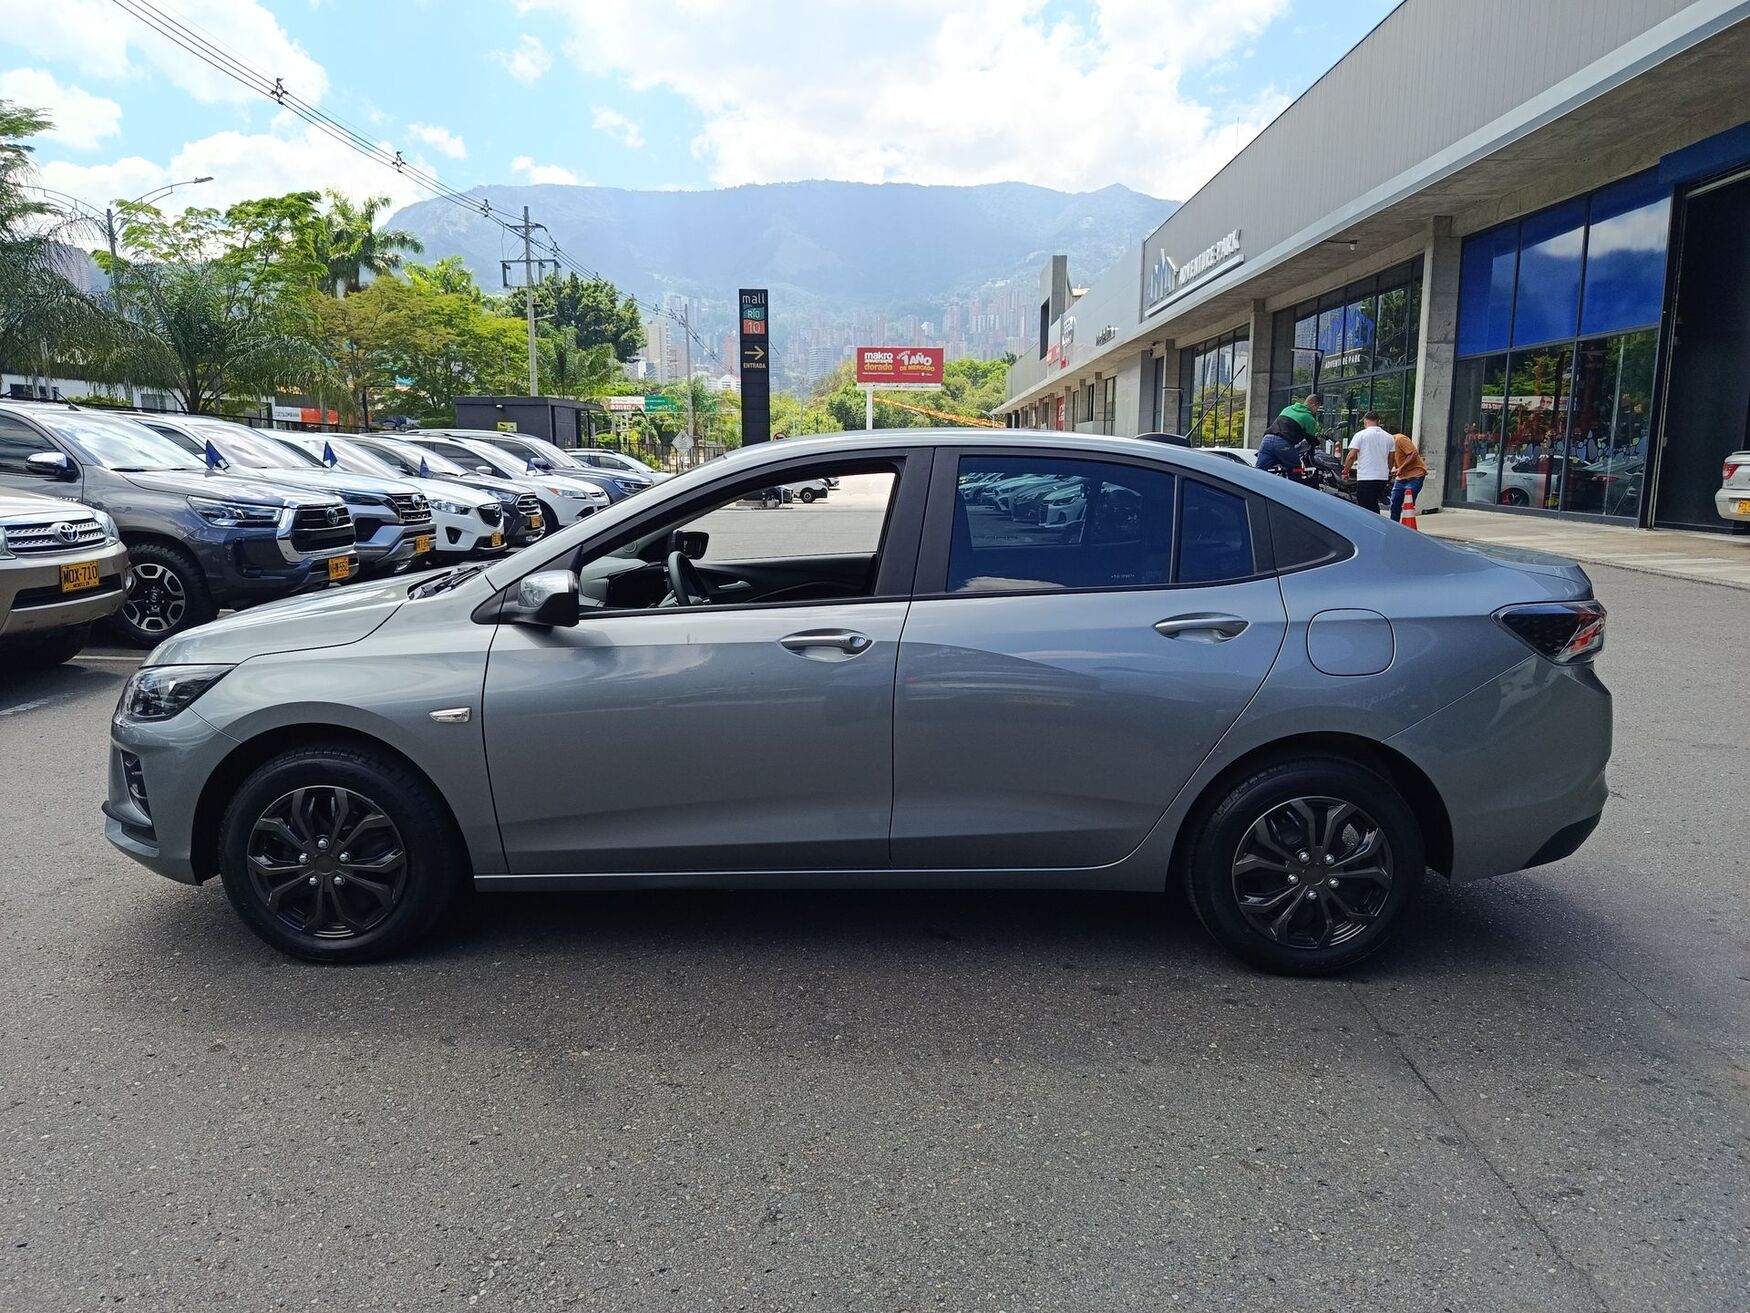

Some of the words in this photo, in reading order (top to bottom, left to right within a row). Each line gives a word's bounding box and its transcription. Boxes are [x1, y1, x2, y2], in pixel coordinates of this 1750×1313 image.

[1178, 245, 1217, 286] ADVENTURE
[1216, 228, 1241, 261] PARK
[742, 293, 765, 304] mall
[747, 322, 761, 334] 10
[864, 352, 893, 361] makro
[909, 352, 933, 366] AÑO
[864, 362, 893, 371] dorado
[907, 364, 935, 372] MERCADO
